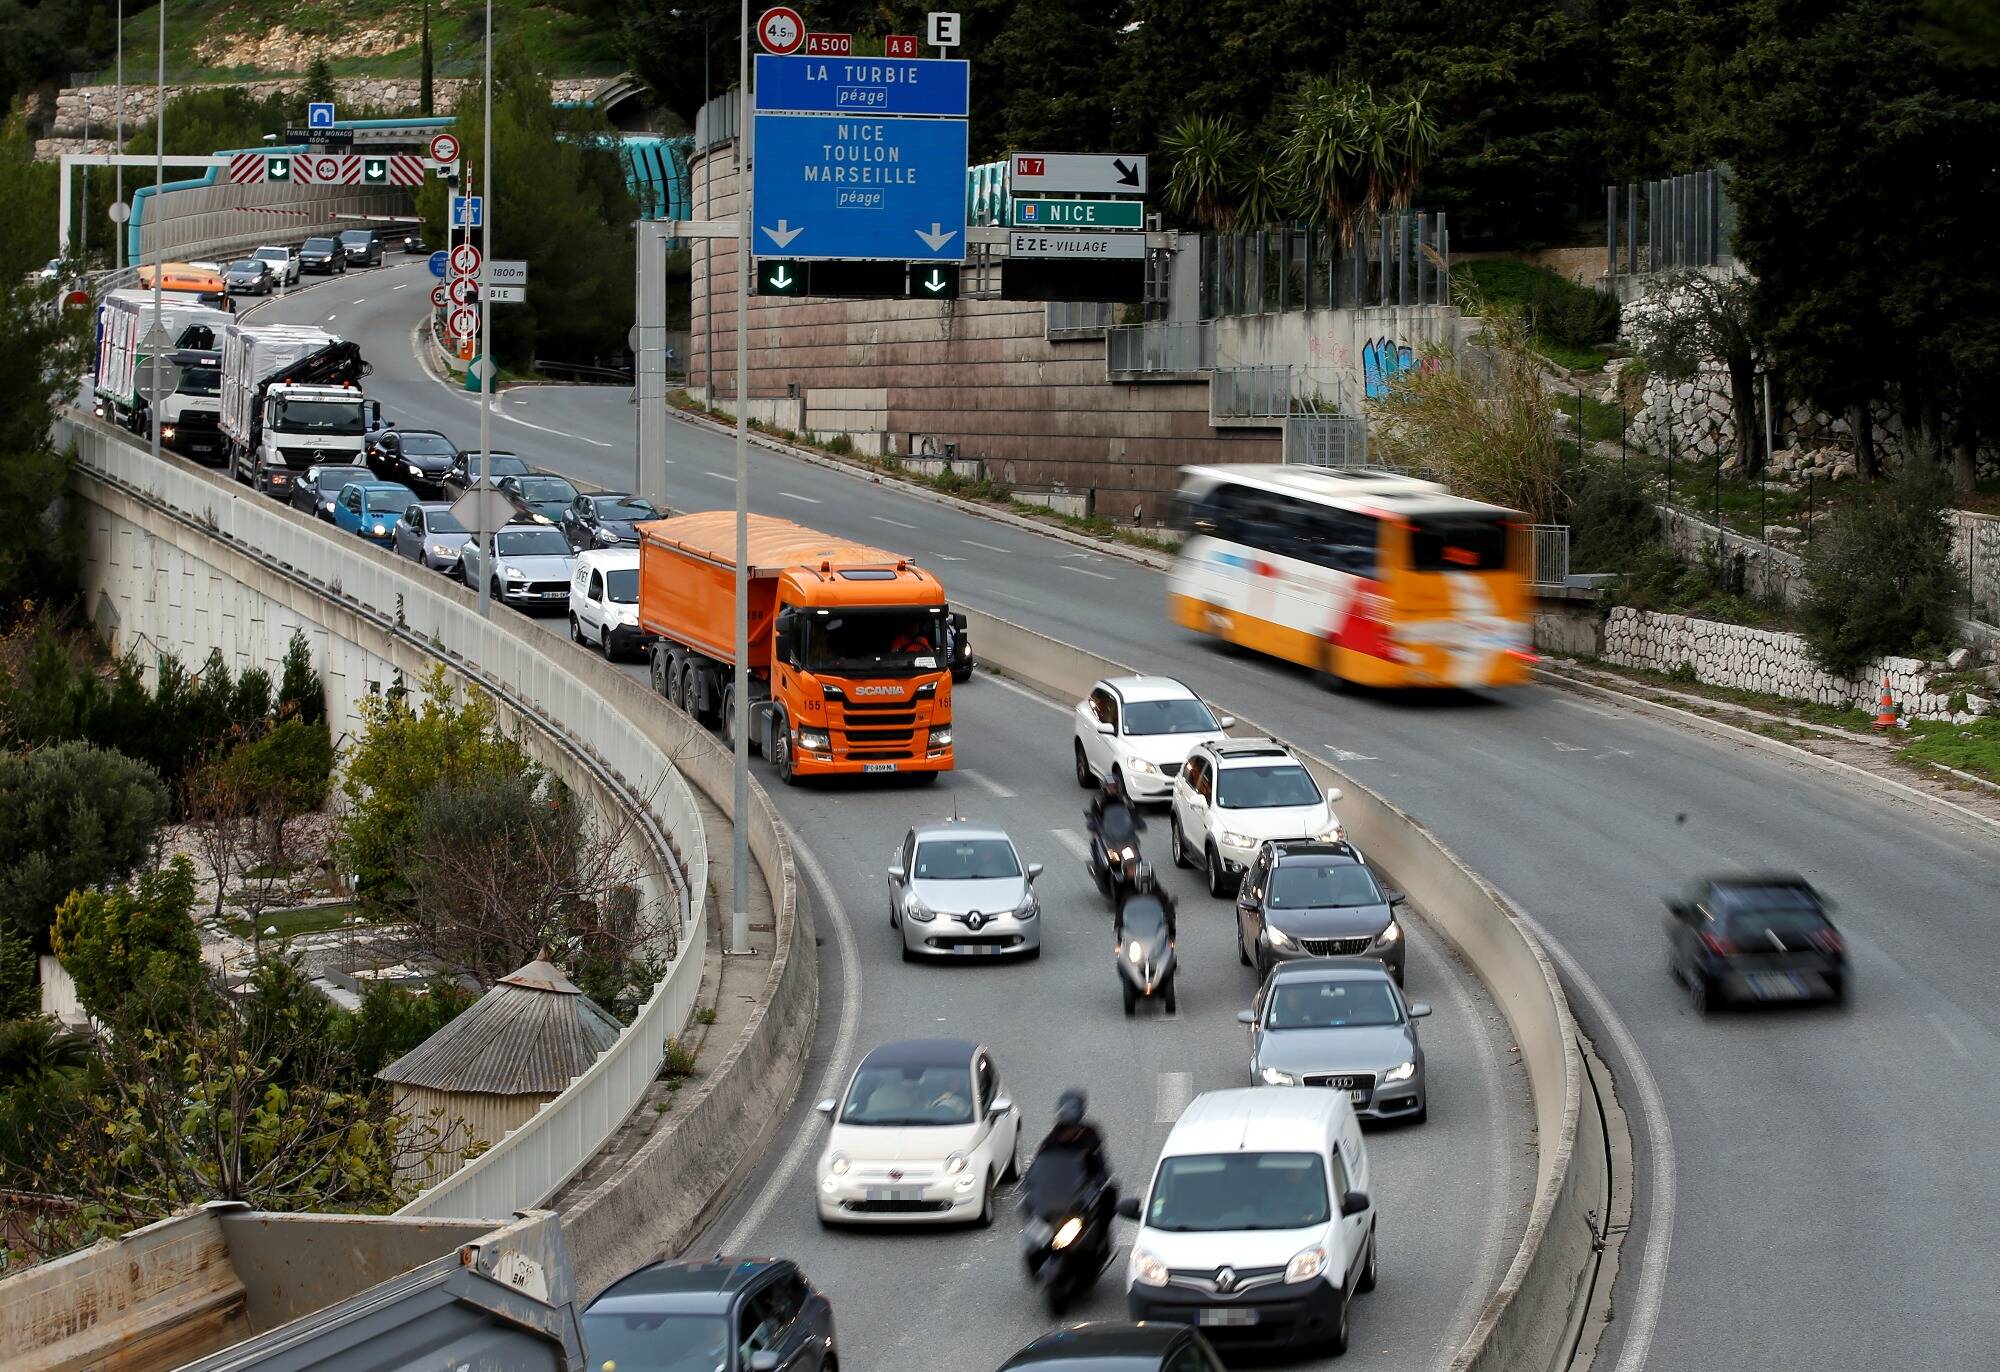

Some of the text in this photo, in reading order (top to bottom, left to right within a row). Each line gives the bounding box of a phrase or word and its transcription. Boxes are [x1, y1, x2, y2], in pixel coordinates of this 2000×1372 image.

[936, 16, 953, 42] E
[806, 65, 918, 84] LA TURBIE
[840, 89, 885, 105] péage
[838, 124, 884, 141] NICE
[823, 144, 899, 162] TOULON
[804, 165, 916, 184] MARSEILLE
[840, 190, 881, 207] péage
[1050, 205, 1095, 222] NICE
[493, 268, 516, 277] 1800
[855, 685, 905, 696] SCANIA
[804, 700, 821, 711] 155
